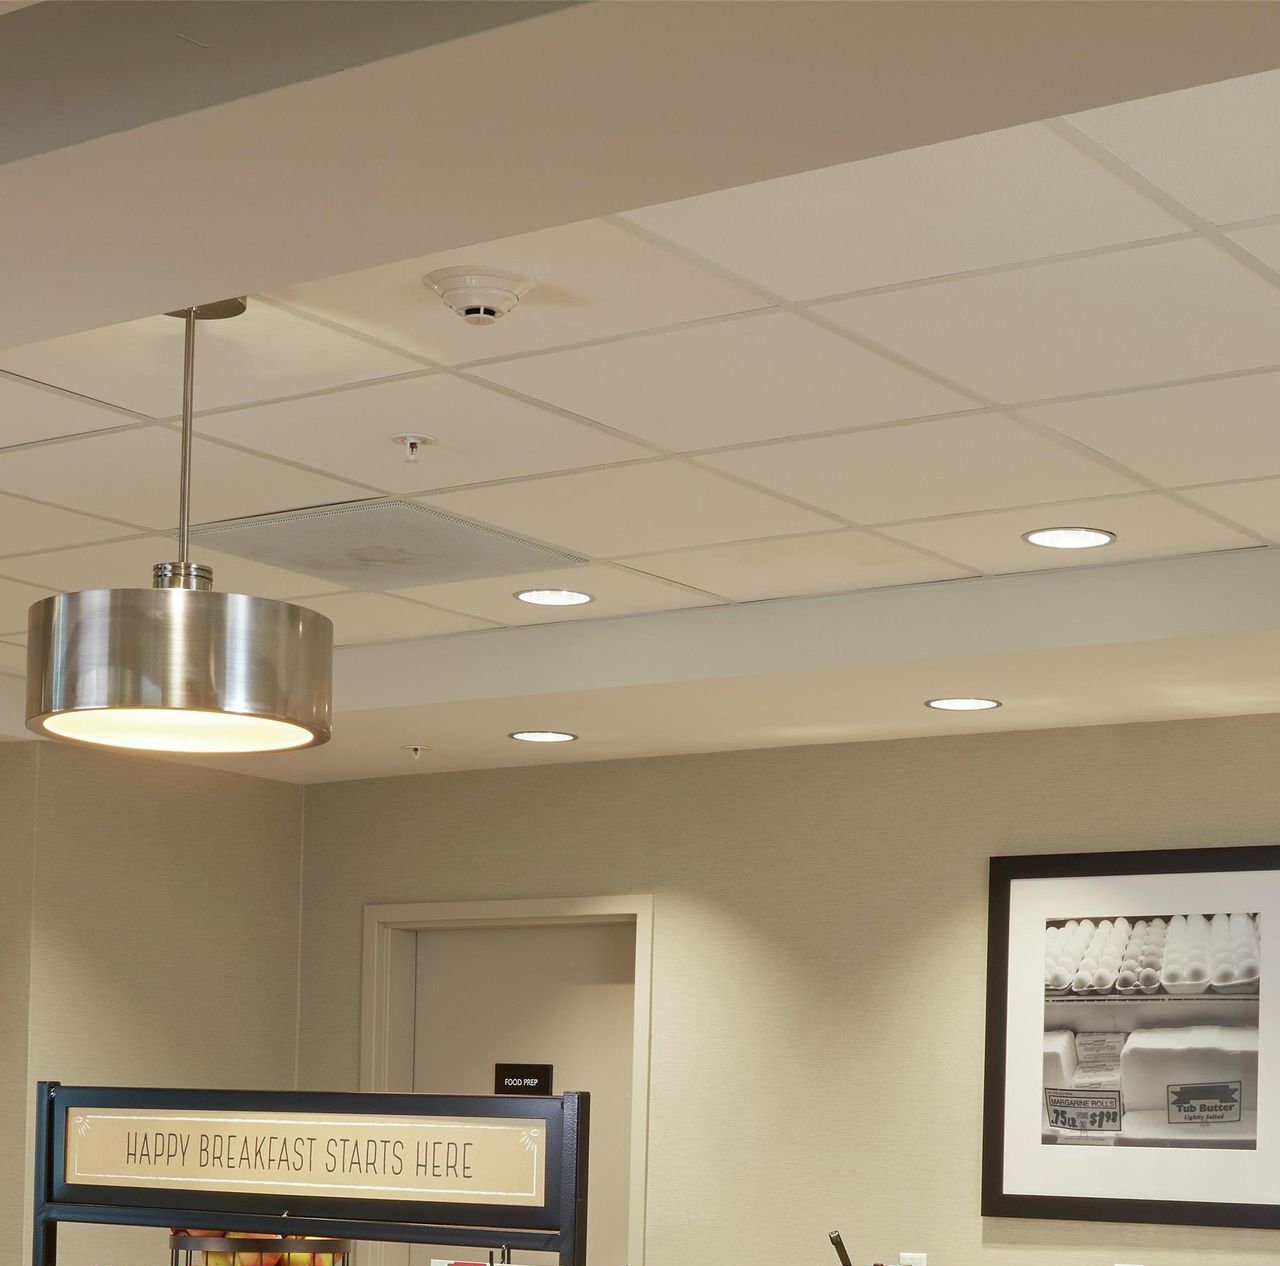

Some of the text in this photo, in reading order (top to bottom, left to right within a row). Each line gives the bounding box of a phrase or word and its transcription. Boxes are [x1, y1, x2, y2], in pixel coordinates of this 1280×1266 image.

[504, 1078, 538, 1086] FOOD PREP
[1051, 1098, 1089, 1107] MARGARINE
[1176, 1104, 1235, 1112] Tub Butter
[126, 1132, 474, 1178] HAPPY BREAKFAST STARTS HERE
